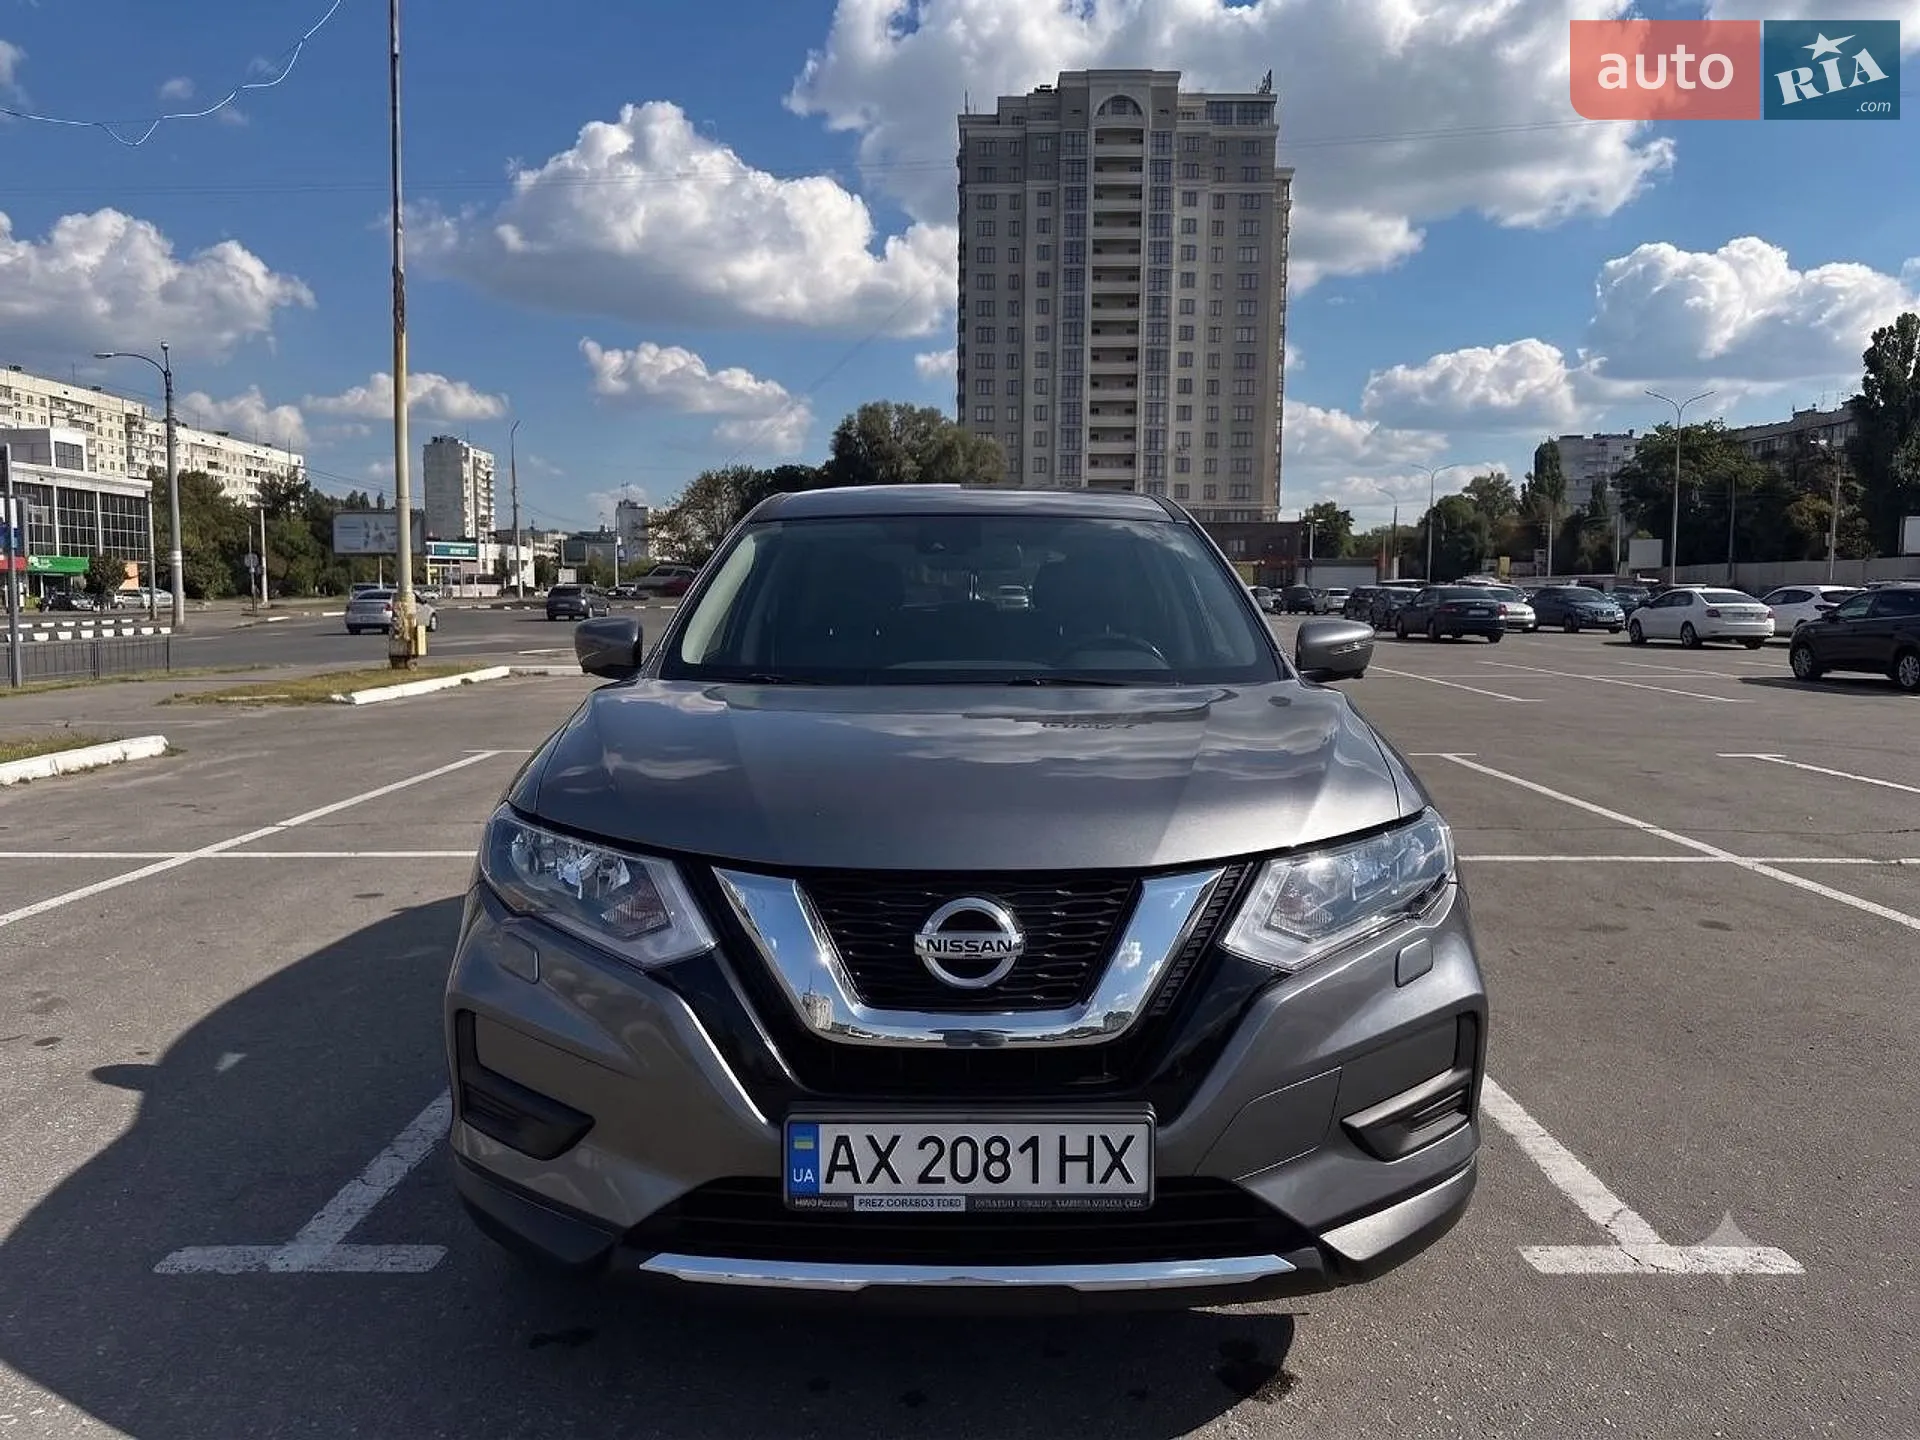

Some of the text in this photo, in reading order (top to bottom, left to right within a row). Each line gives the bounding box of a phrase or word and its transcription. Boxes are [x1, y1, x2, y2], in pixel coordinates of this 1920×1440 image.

[926, 939, 1013, 953] NISSAN
[825, 1135, 1135, 1185] AX 2081 HX
[793, 1168, 815, 1182] UA
